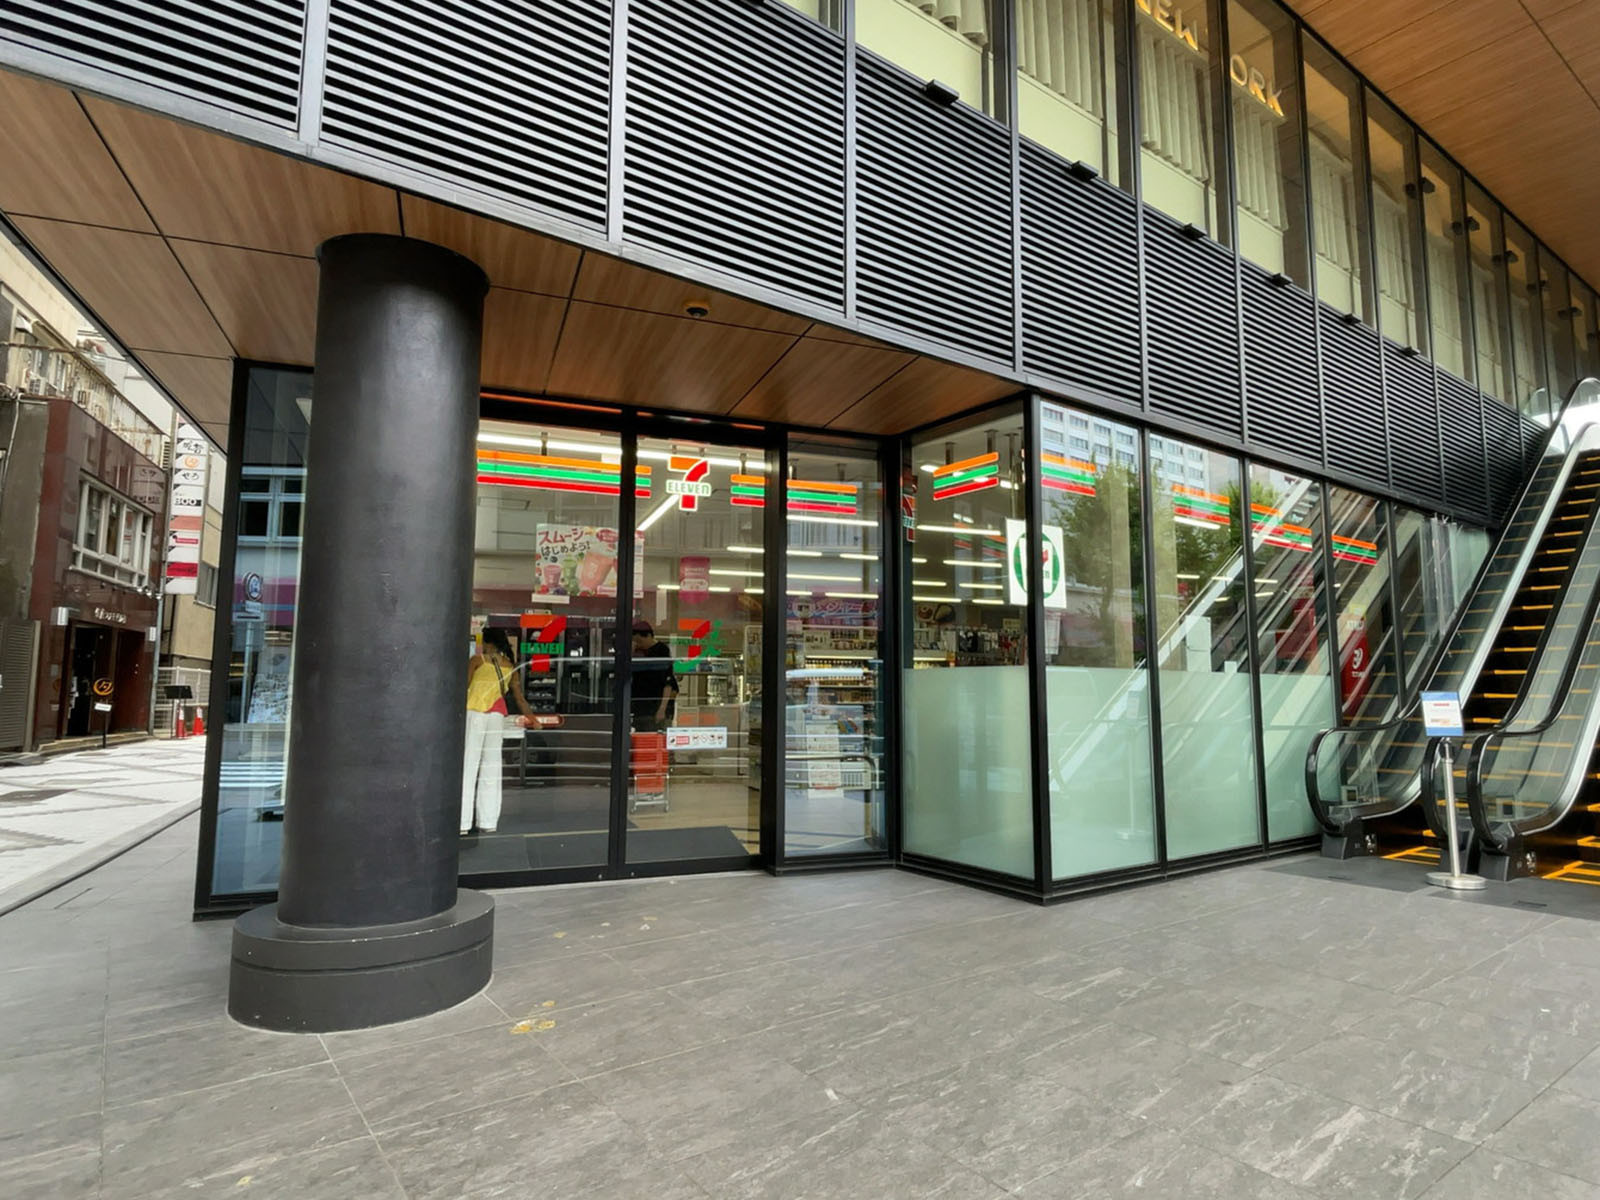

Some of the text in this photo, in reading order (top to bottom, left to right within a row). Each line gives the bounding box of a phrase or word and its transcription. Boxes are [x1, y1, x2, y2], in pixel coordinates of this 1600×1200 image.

[1230, 54, 1284, 117] ORK
[538, 527, 593, 546] スムージー
